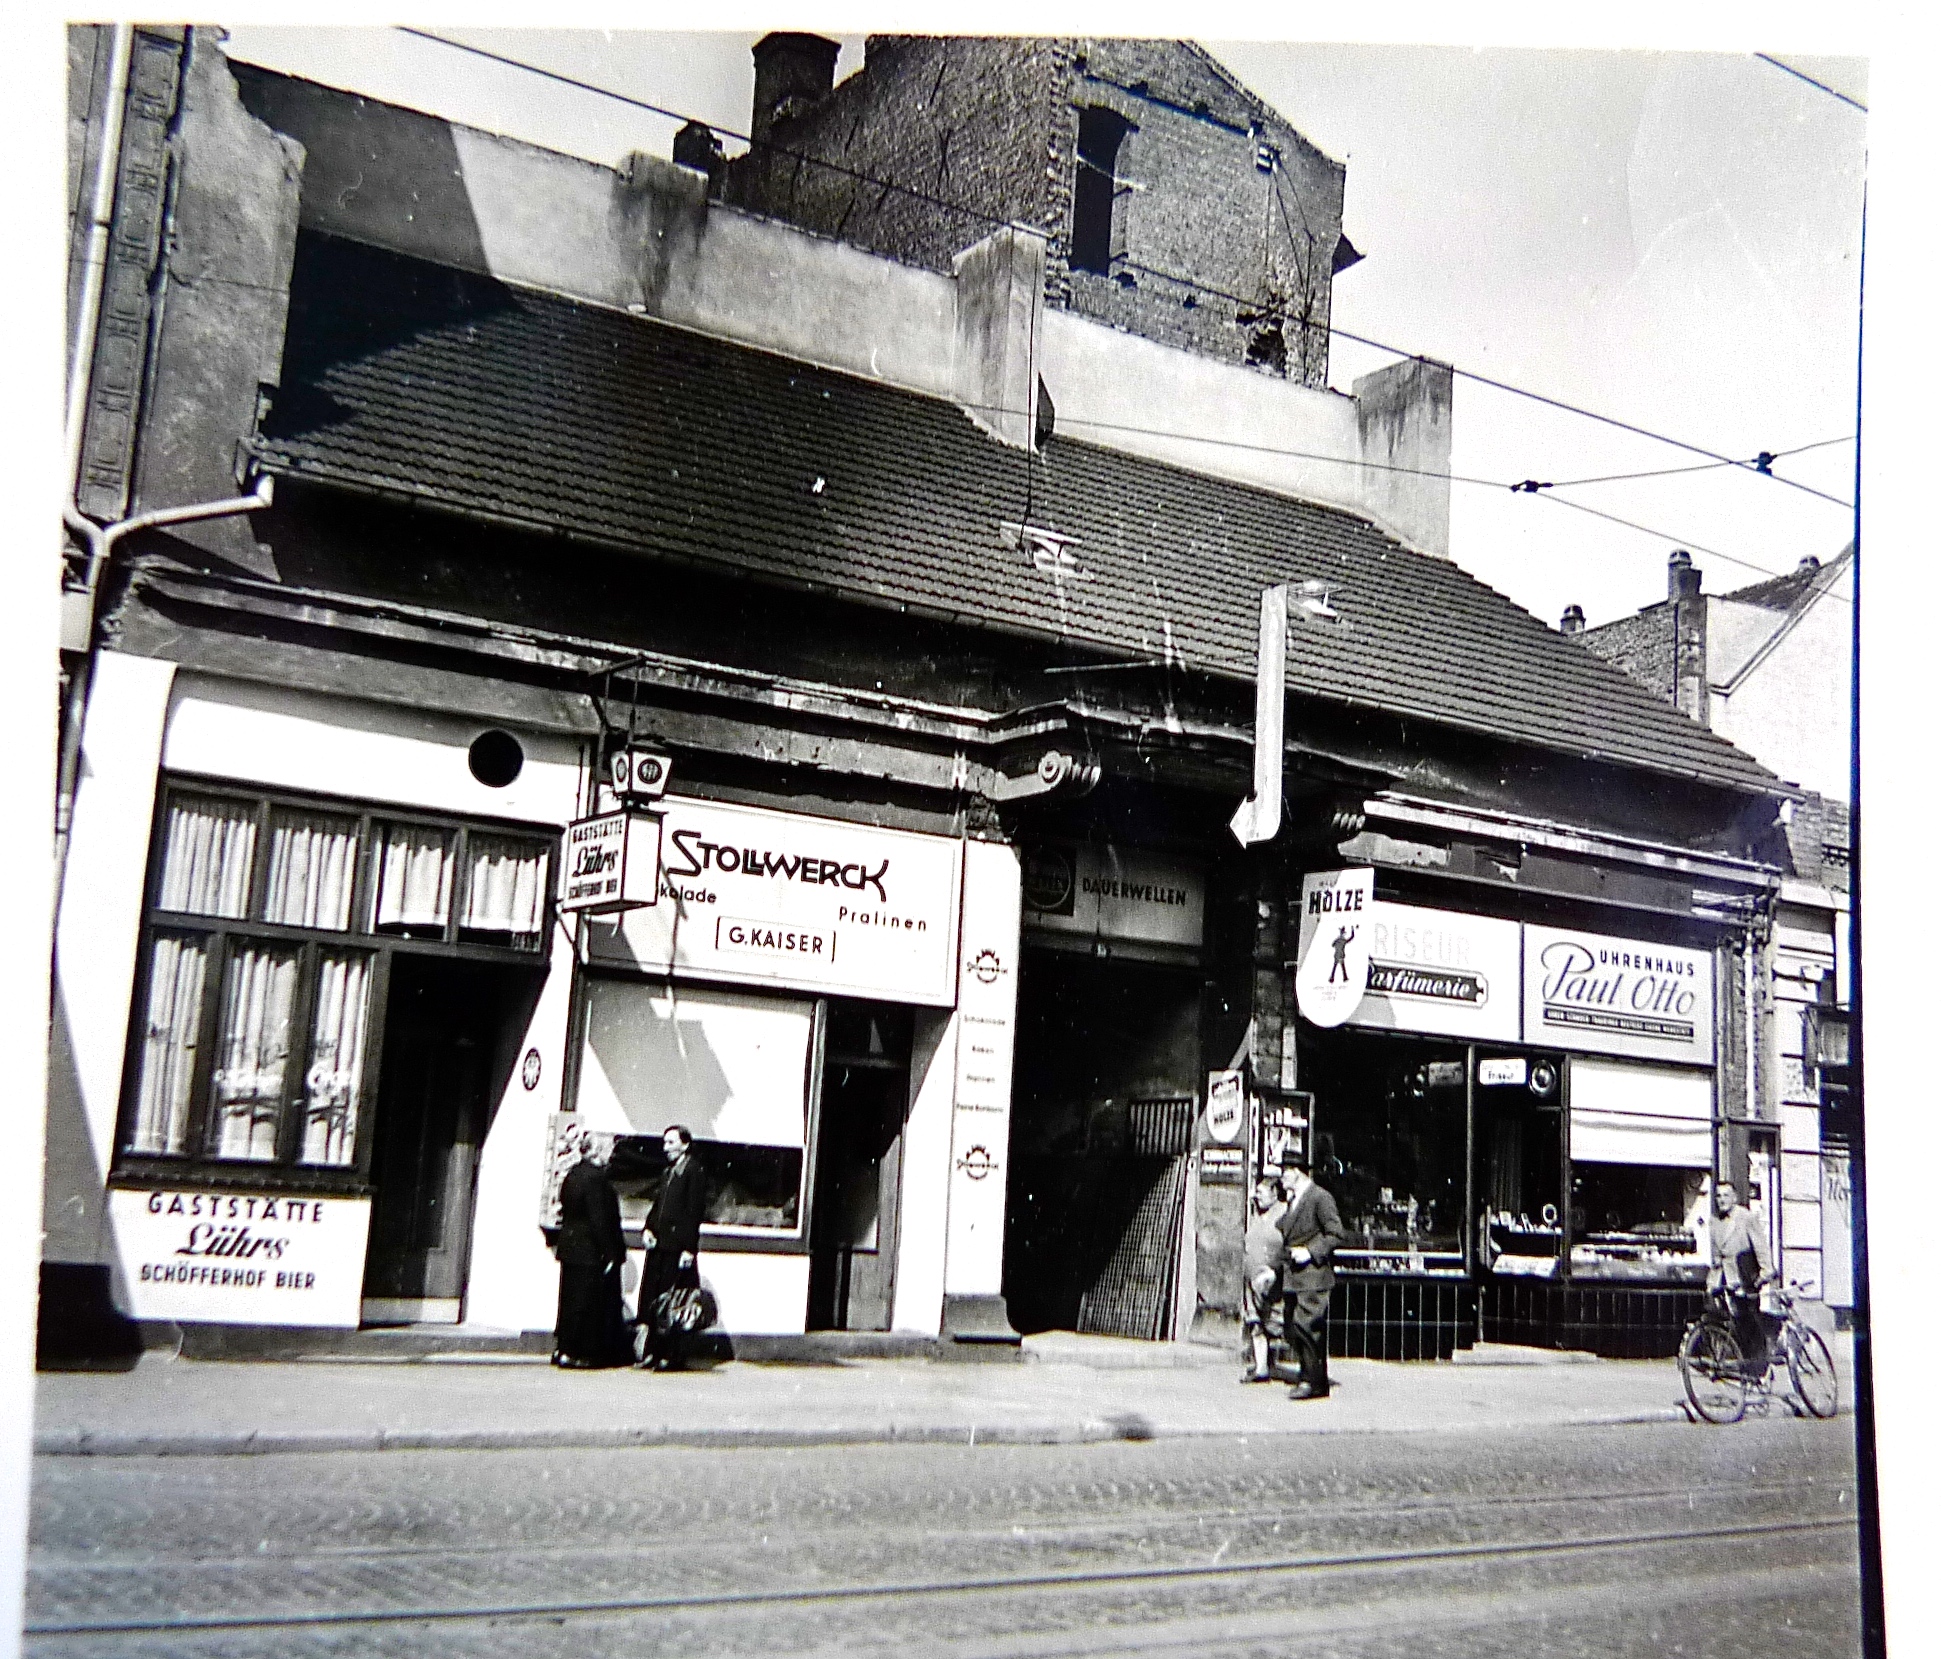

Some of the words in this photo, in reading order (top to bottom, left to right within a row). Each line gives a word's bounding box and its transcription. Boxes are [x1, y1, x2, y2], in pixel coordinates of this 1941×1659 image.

[572, 844, 618, 877] Lührs
[660, 882, 717, 904] kolade
[1082, 877, 1186, 907] DAUERWELLEN
[839, 906, 926, 931] Pralinen
[1374, 922, 1470, 964] RISEUR
[1600, 949, 1694, 977] UHRENHAUS
[1541, 942, 1623, 1004] Paul
[1632, 974, 1695, 1016] Otto
[148, 1191, 324, 1222] GASTSTÄTTE
[175, 1222, 290, 1259] Lührs
[141, 1261, 267, 1288] SCHÖFFERHOF
[276, 1272, 316, 1289] BIER
